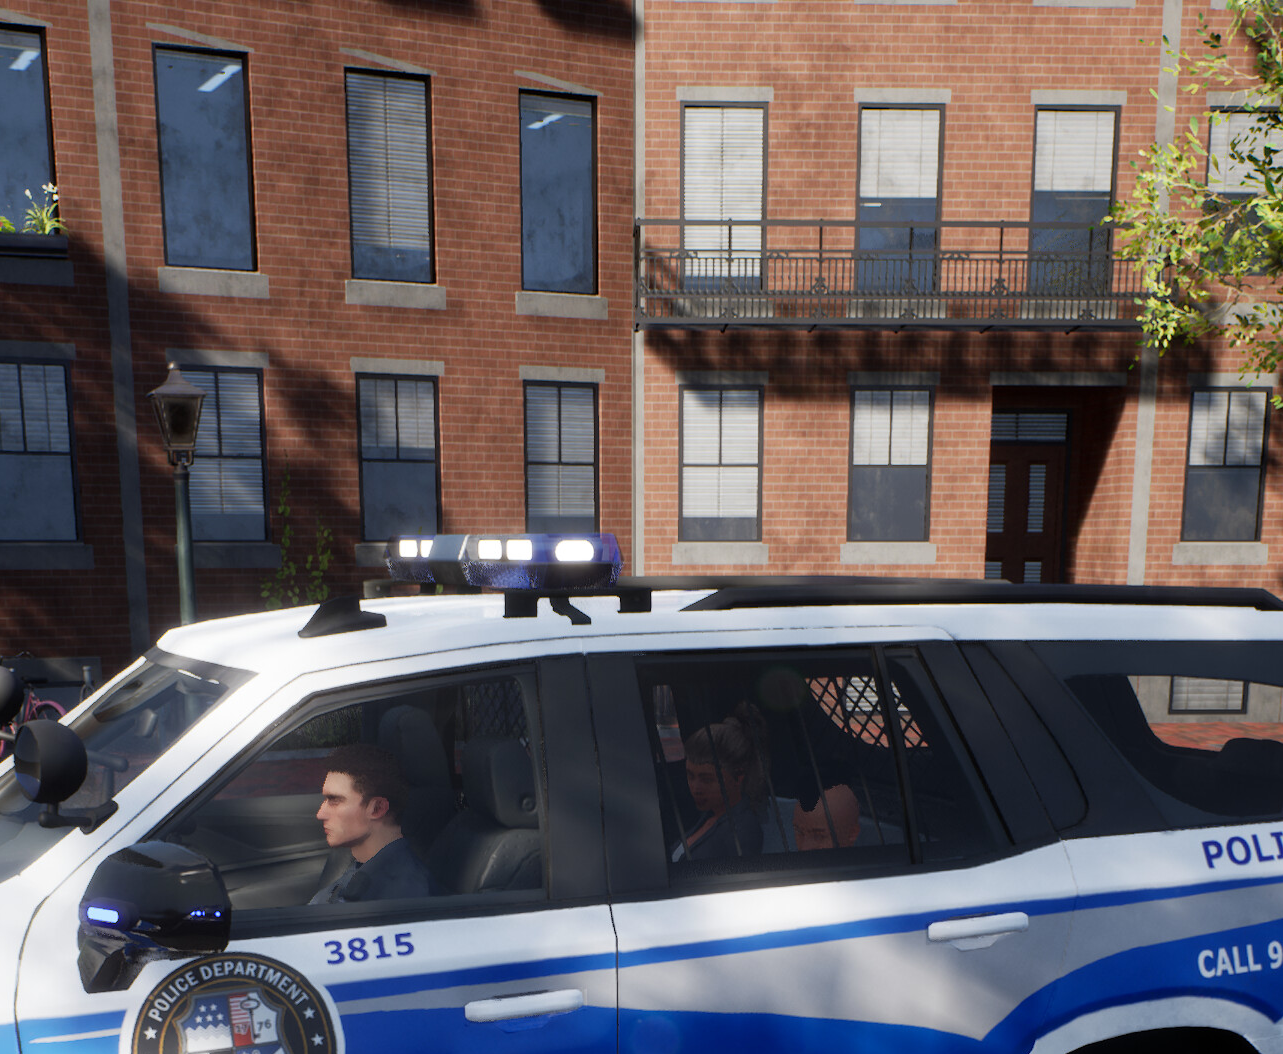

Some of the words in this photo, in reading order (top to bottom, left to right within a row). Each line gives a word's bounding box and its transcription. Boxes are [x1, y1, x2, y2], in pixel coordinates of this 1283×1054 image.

[324, 932, 414, 965] 3815
[1198, 944, 1262, 978] CALL
[148, 969, 199, 1022] POLICE
[200, 961, 310, 1006] DEPARTMENT
